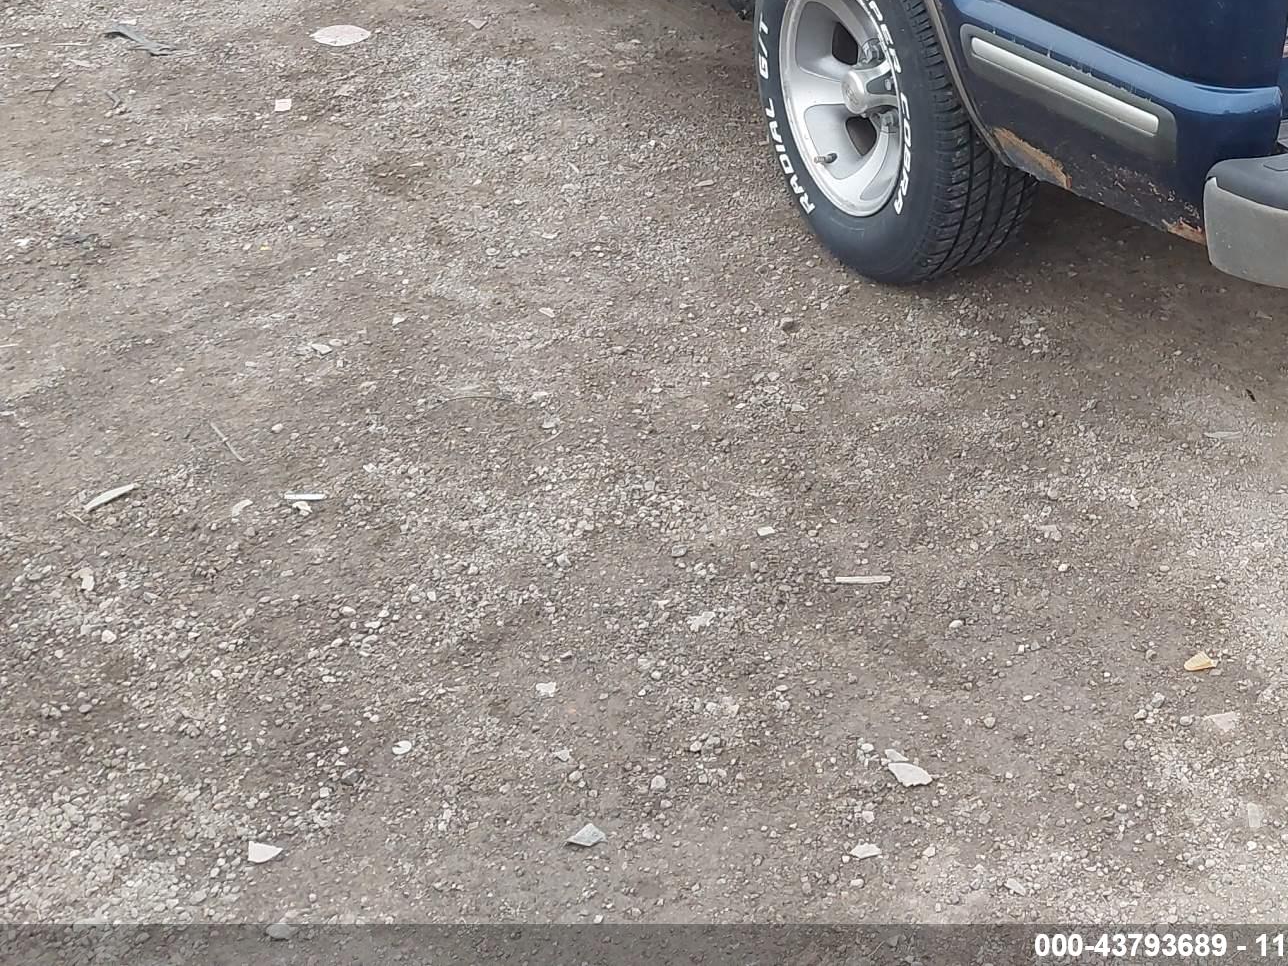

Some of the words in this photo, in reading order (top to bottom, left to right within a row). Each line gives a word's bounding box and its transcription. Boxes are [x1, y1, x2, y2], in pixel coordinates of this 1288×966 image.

[757, 13, 769, 80] G/T
[765, 97, 816, 215] RADIAL
[894, 92, 914, 216] COBRA
